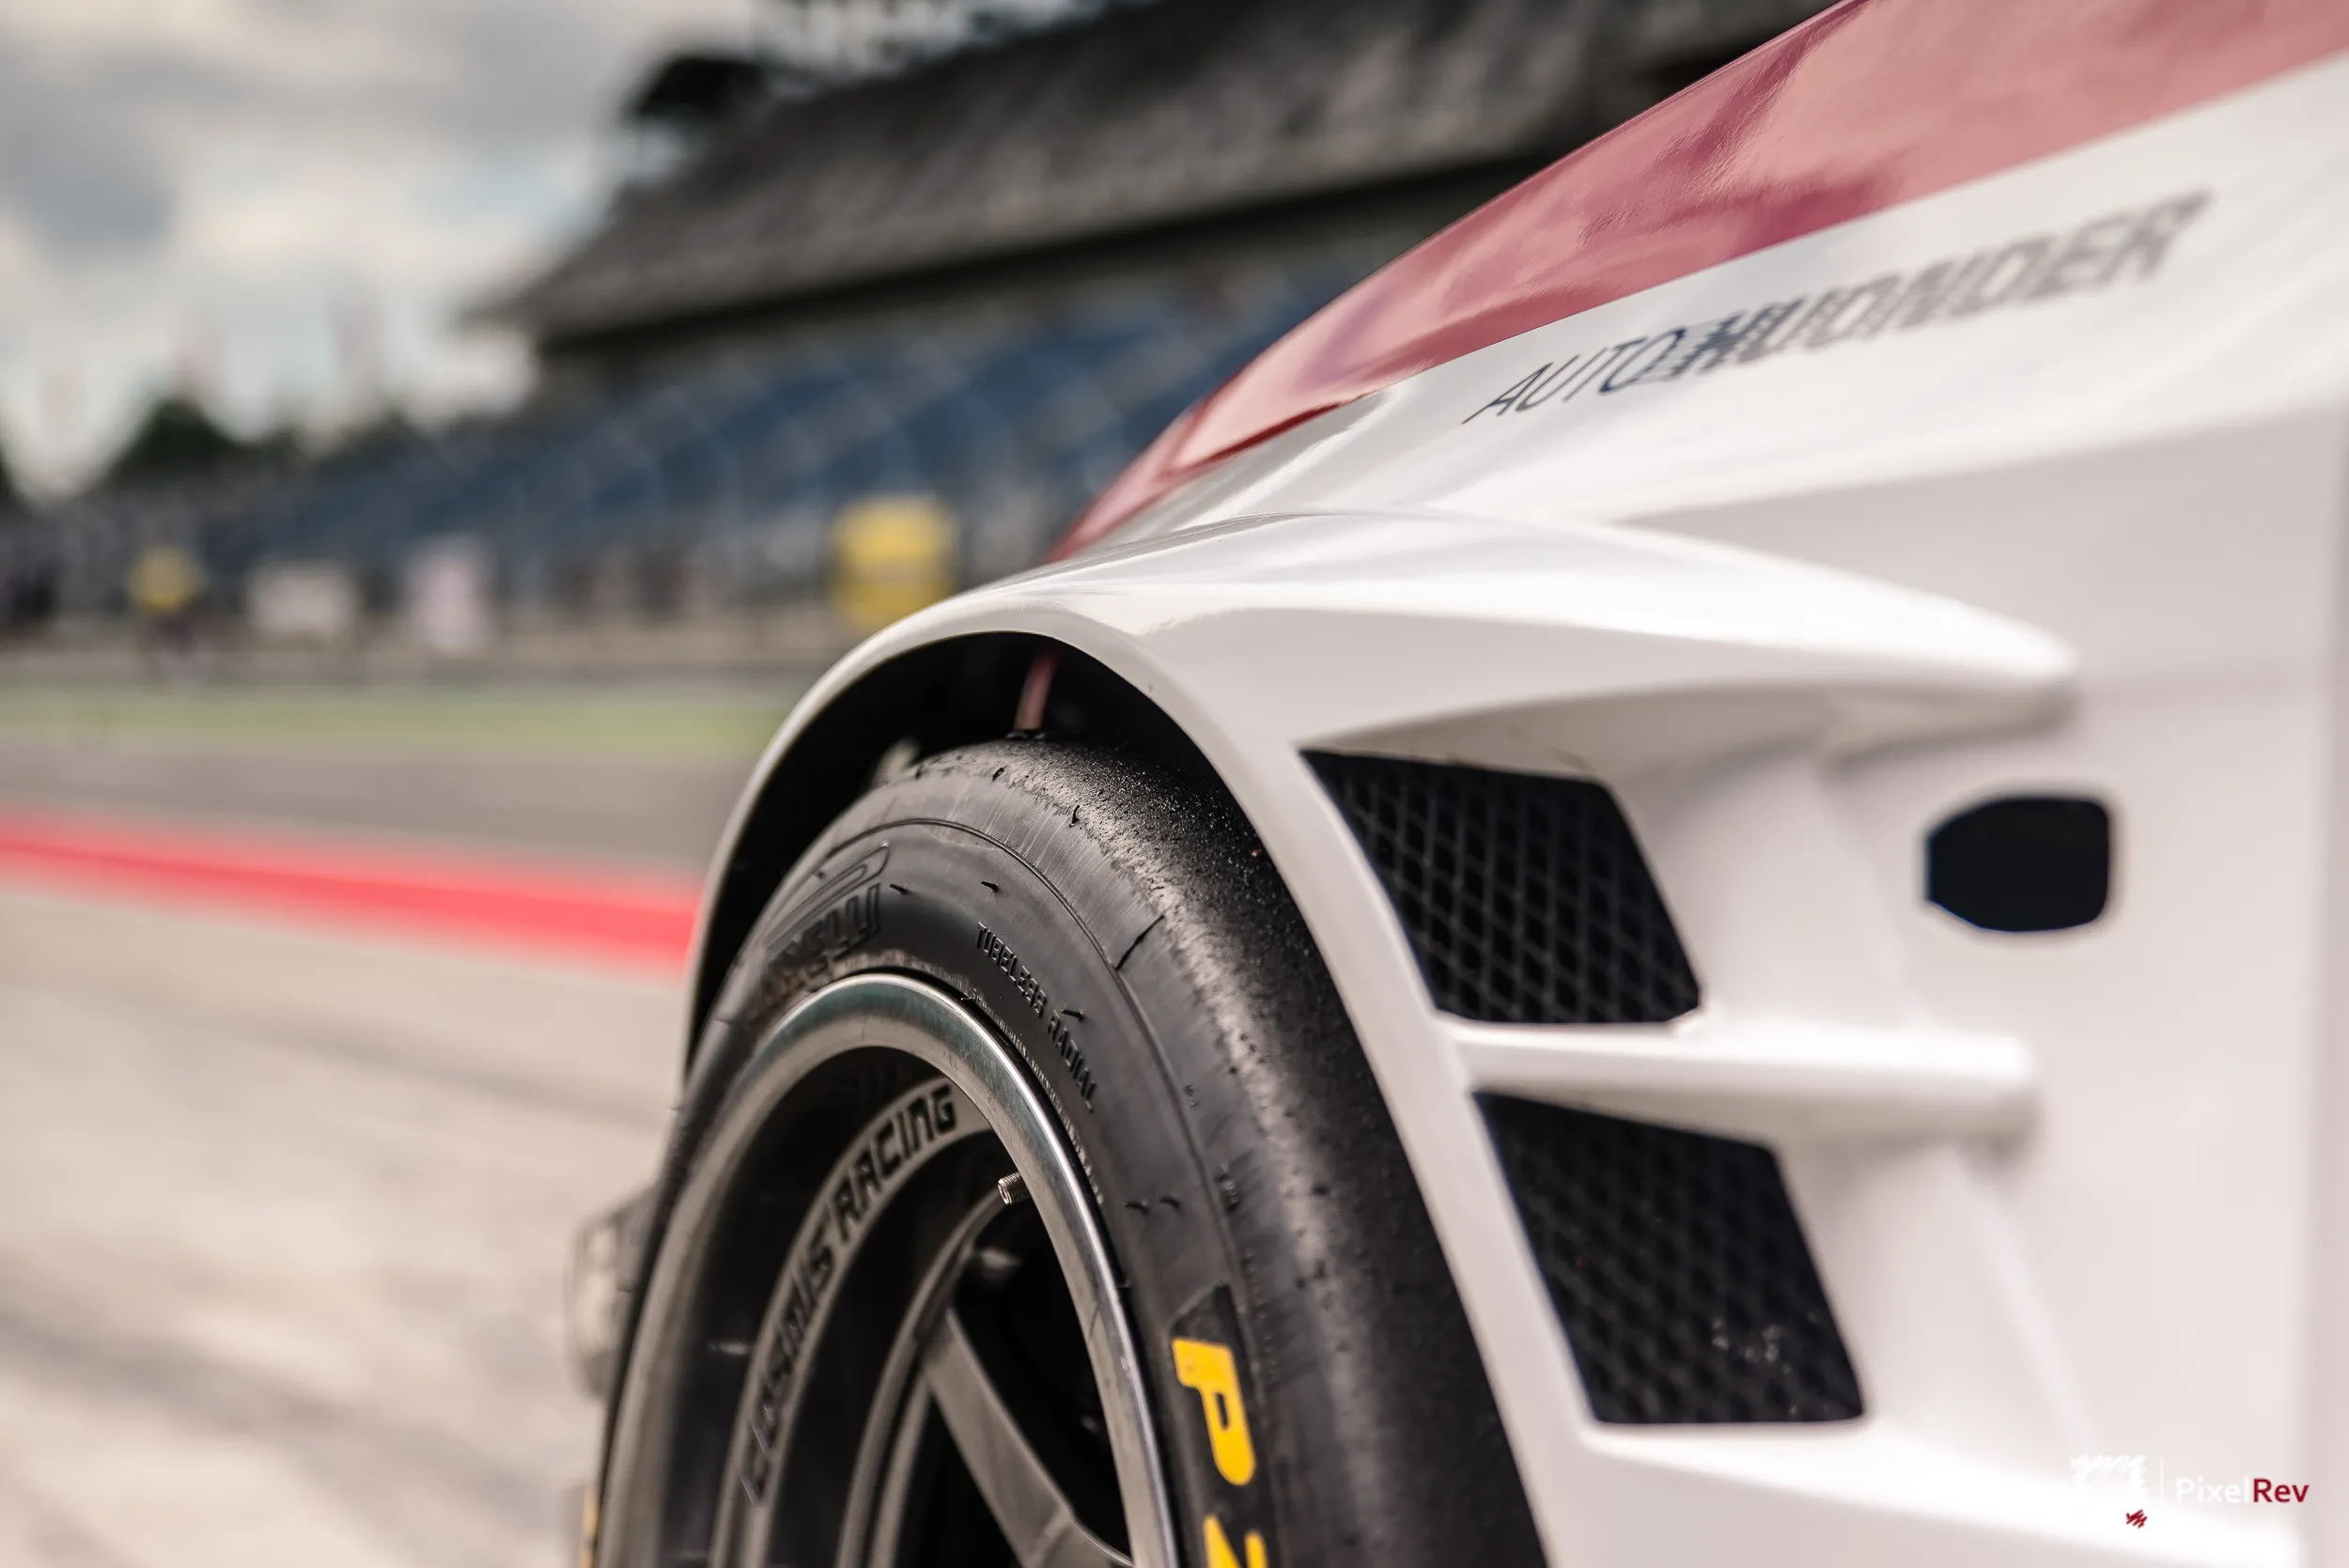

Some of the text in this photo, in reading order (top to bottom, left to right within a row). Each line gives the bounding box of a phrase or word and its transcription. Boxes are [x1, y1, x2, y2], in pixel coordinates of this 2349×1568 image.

[976, 921, 1097, 1113] TUBELESS RADIAL
[826, 1083, 957, 1242] RACING
